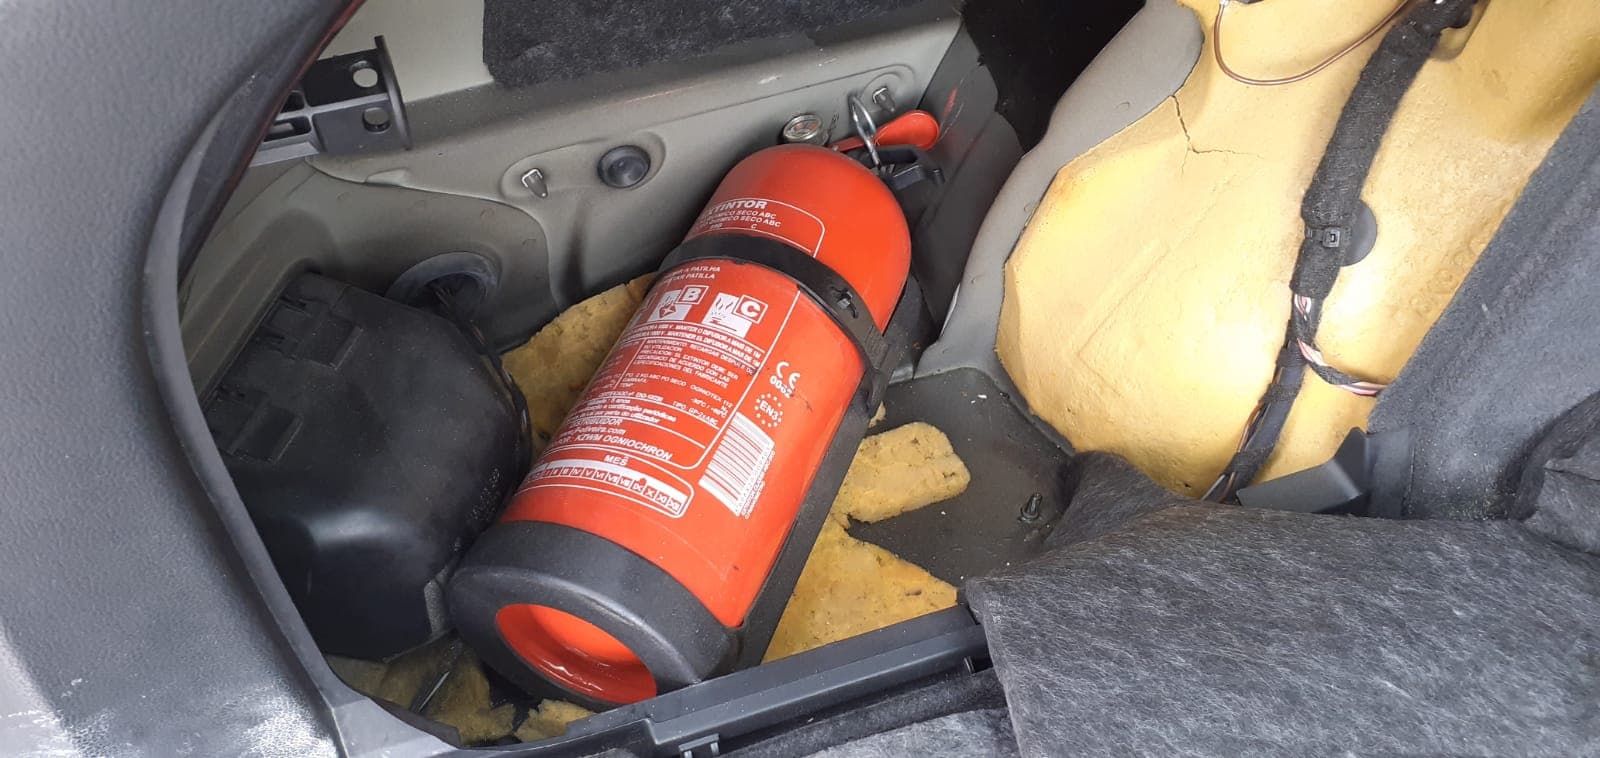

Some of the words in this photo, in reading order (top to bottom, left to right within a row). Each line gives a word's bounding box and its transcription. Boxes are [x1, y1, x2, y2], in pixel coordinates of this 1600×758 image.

[758, 210, 777, 220] ABC
[763, 218, 782, 228] ABC
[681, 287, 702, 302] B
[740, 300, 761, 318] C
[759, 399, 779, 421] EN3
[603, 434, 673, 461] OGNIOCHRON
